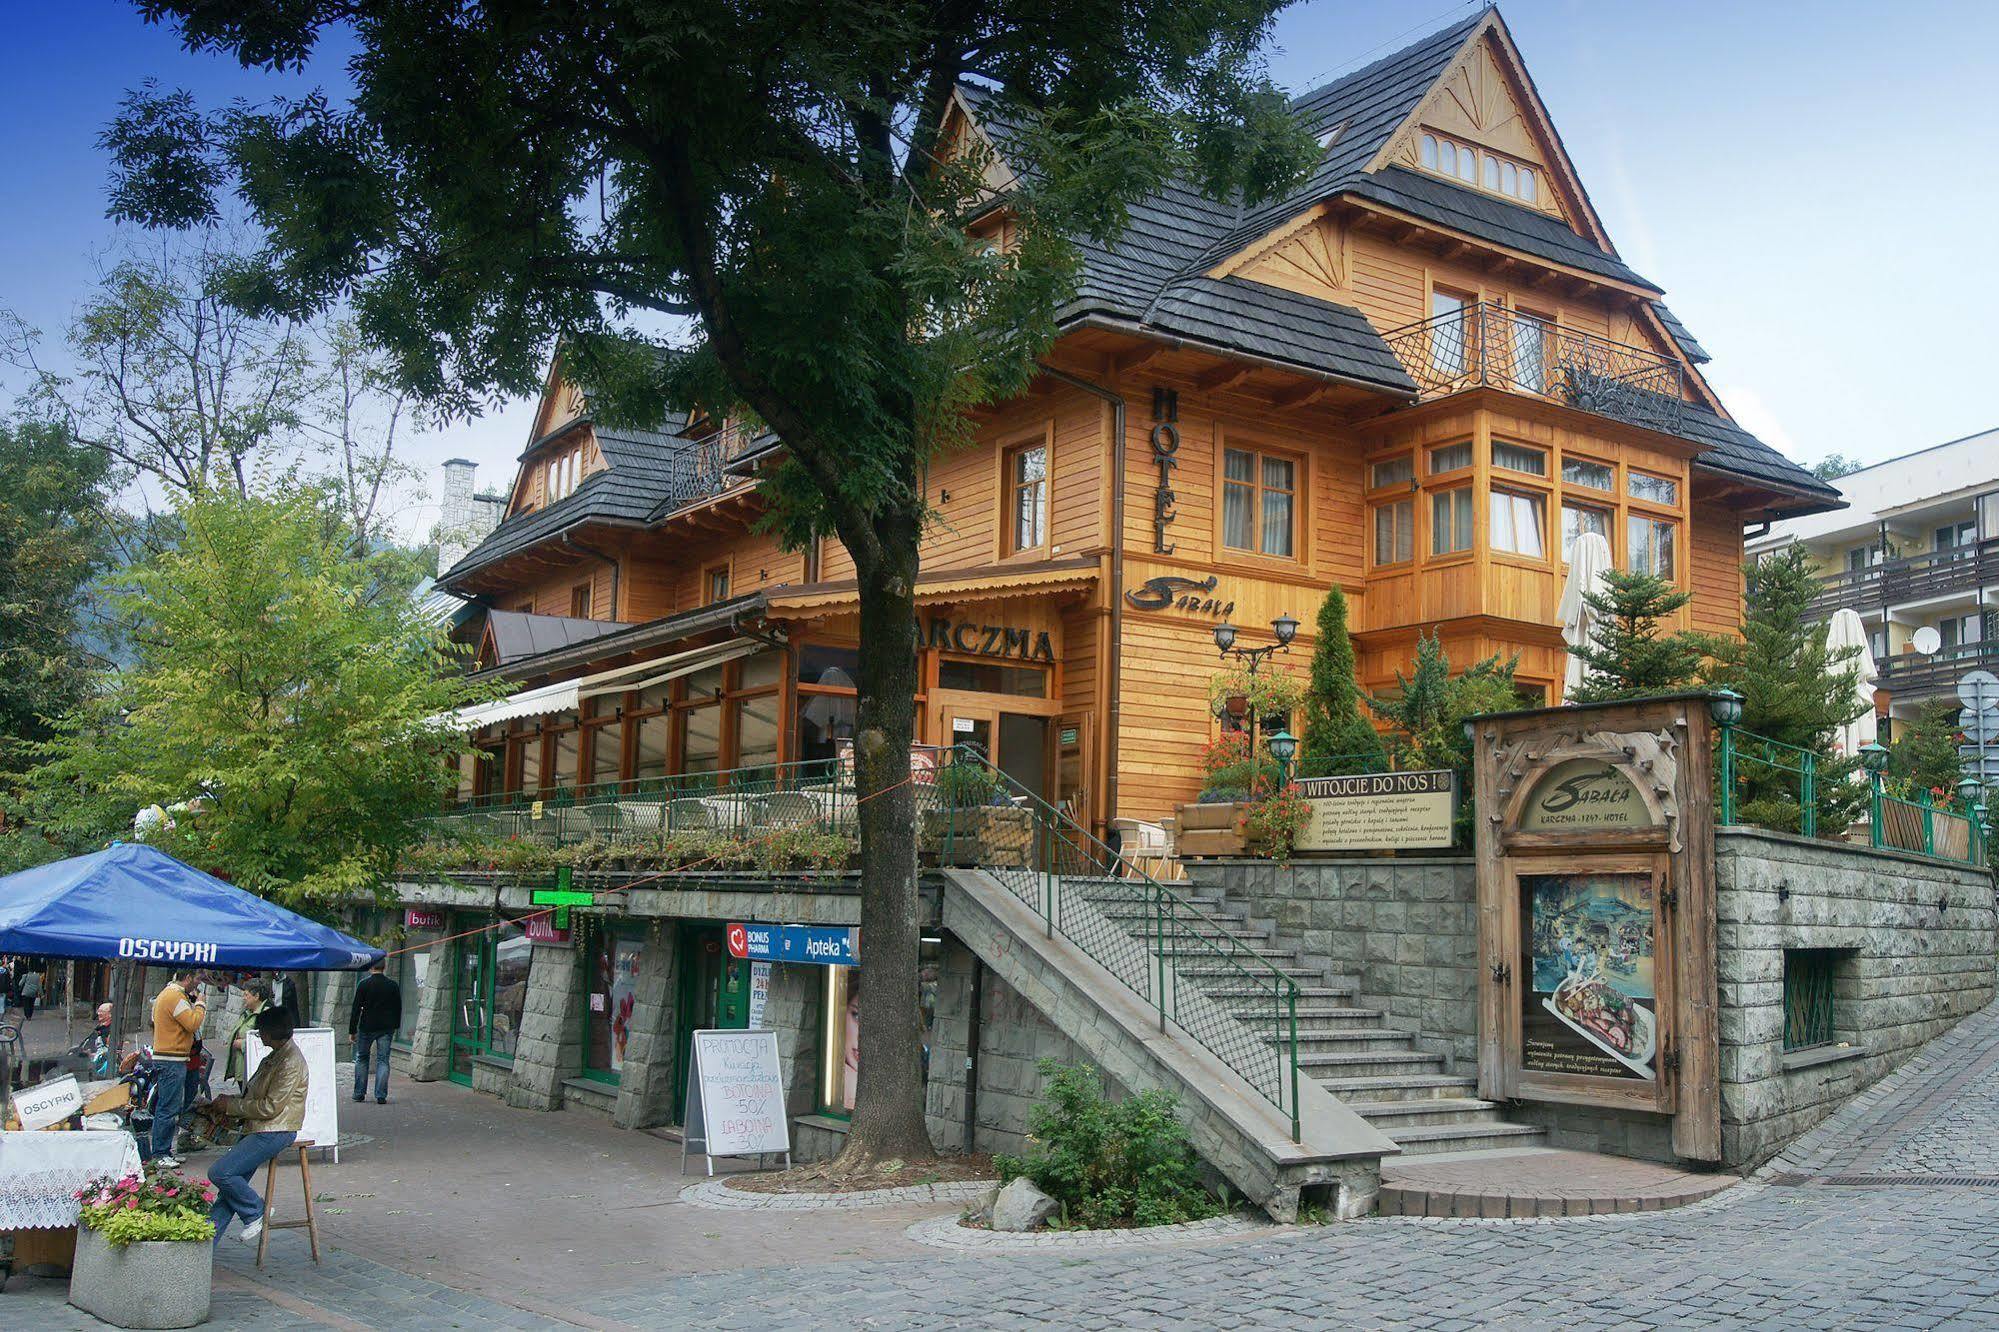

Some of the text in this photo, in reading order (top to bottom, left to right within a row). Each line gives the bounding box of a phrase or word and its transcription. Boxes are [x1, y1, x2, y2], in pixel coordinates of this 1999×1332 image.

[1152, 387, 1180, 555] HOTEL
[1307, 774, 1437, 796] WITOJCIE DO NOS !
[1604, 813, 1629, 822] HOTEL
[412, 915, 440, 925] butik
[747, 931, 770, 943] BONUS
[119, 937, 217, 963] OSCYPKI
[747, 944, 770, 954] PHARMA
[806, 937, 840, 959] Apteka
[704, 1039, 768, 1059] PROMOCJA
[23, 1092, 74, 1115] OSCYPKI
[735, 1099, 767, 1116] -50%
